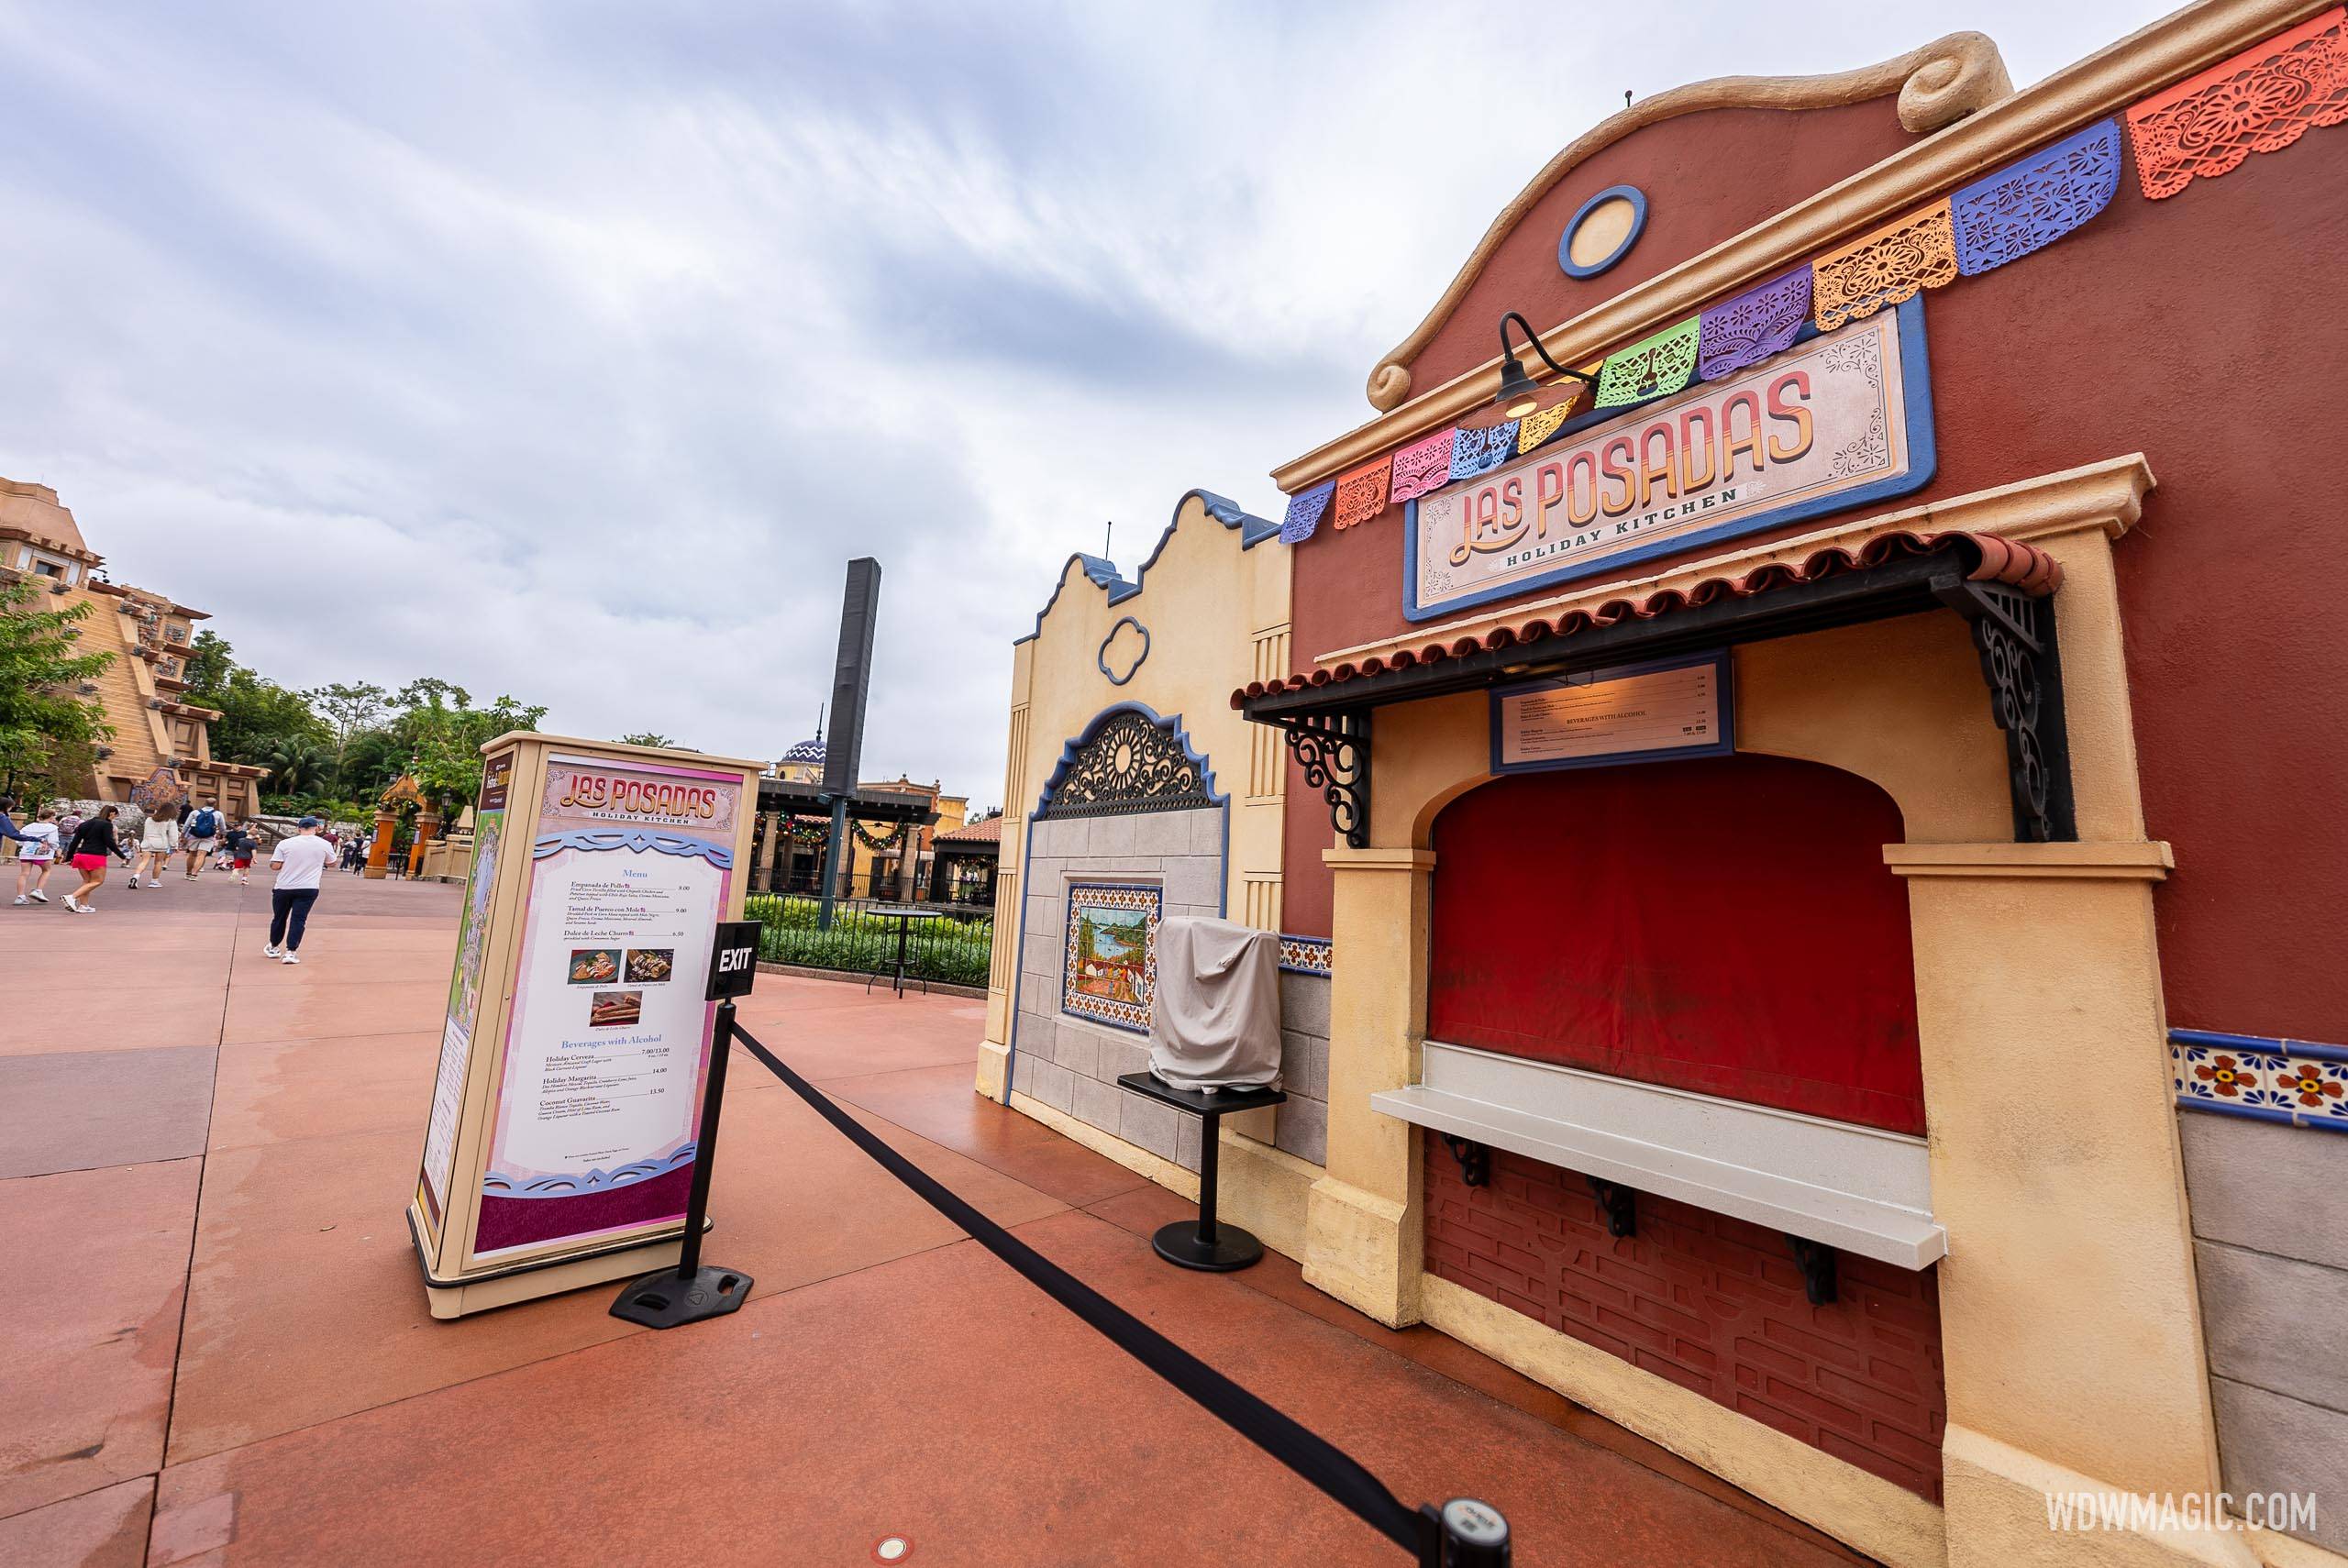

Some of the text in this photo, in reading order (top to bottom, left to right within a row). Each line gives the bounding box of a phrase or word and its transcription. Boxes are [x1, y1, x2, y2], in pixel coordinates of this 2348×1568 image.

[1449, 370, 1813, 567] LAS POSADAS
[1507, 489, 1736, 567] HOLIDAY KITCHEN
[1567, 711, 1645, 724] BEVERAGES WITH ALCOHOL
[559, 775, 715, 819] LAS POSADAS
[593, 812, 689, 824] HOLIDAY KITCHEN
[624, 869, 648, 878] Menu
[570, 881, 602, 889] Empanada
[719, 947, 752, 973] EXIT
[561, 1034, 661, 1049] Beverages with Alcohol
